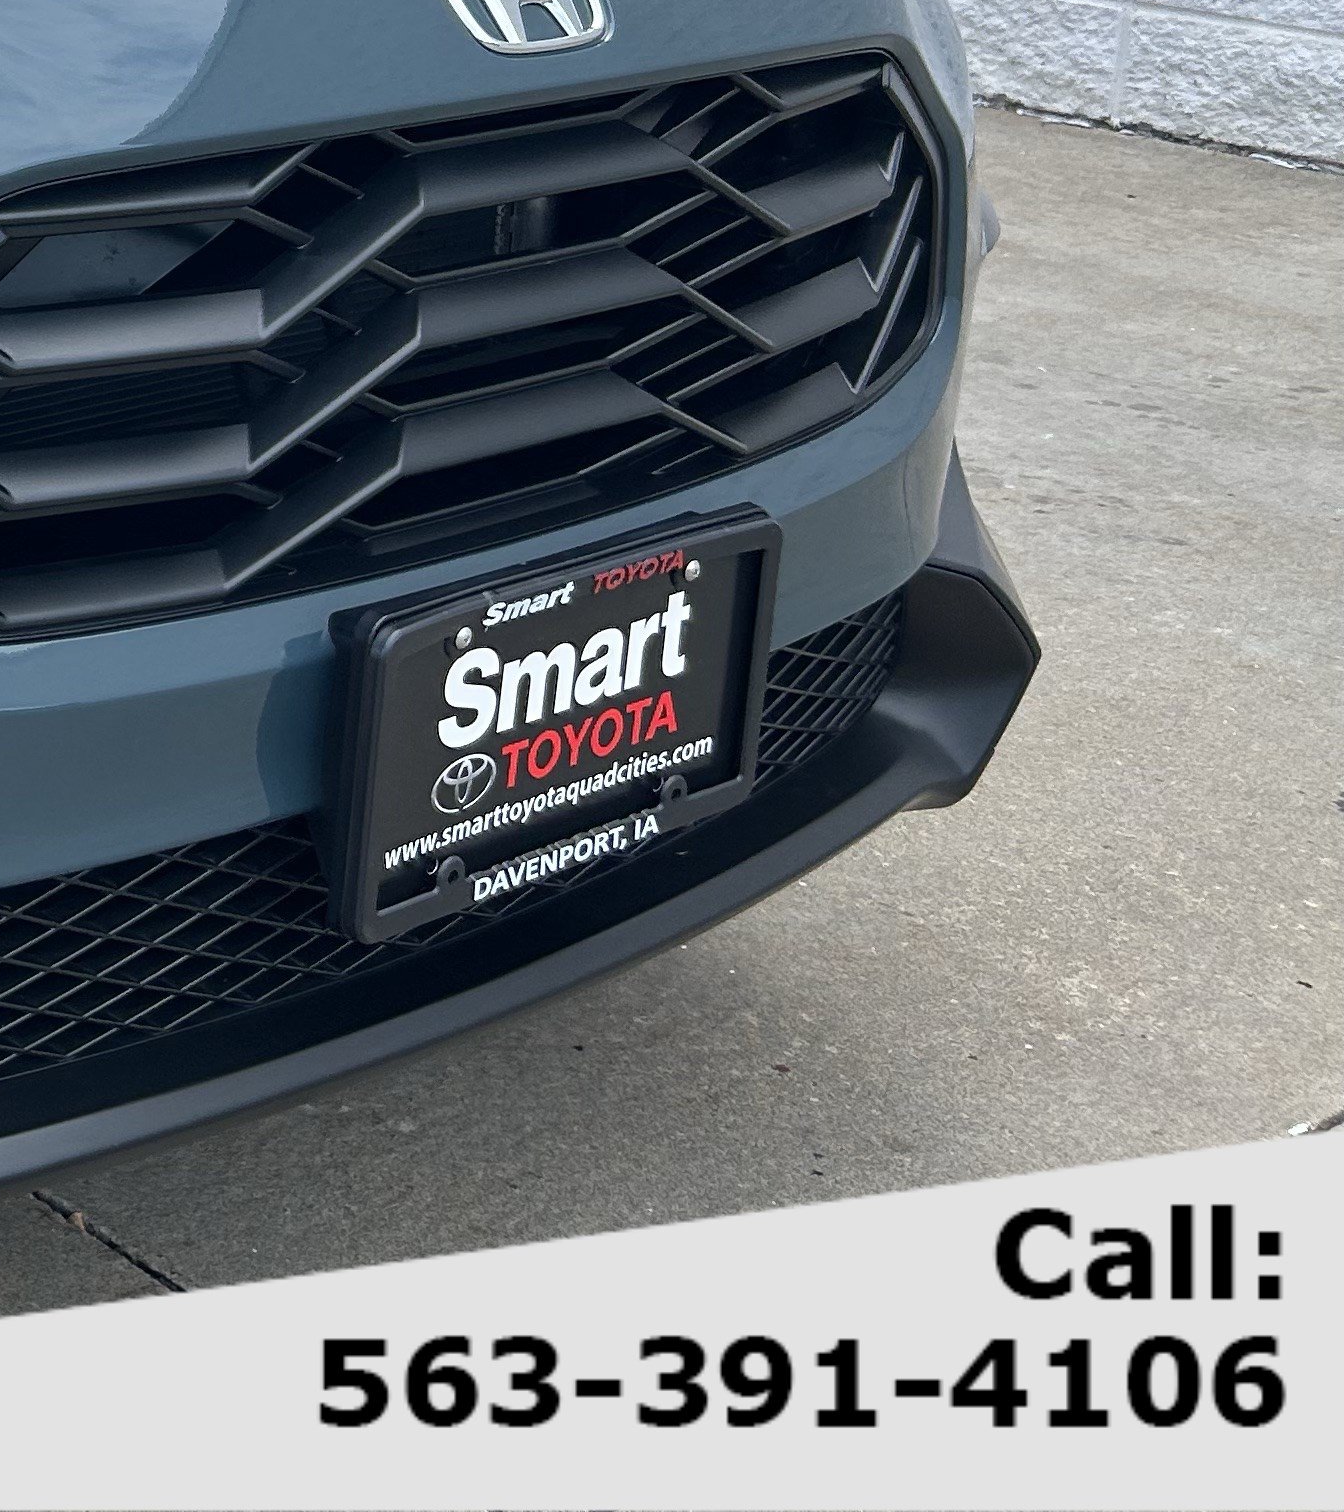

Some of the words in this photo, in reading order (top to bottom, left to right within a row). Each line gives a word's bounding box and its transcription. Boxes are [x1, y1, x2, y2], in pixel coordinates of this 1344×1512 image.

[482, 580, 576, 627] Smart
[593, 549, 685, 595] TOYOTA
[437, 591, 691, 749] Smart
[501, 691, 678, 789] TOYOTA
[383, 735, 713, 870] www.smarttoyotaquadcities.com
[472, 824, 629, 902] DAVENPORT,
[634, 814, 660, 842] IA
